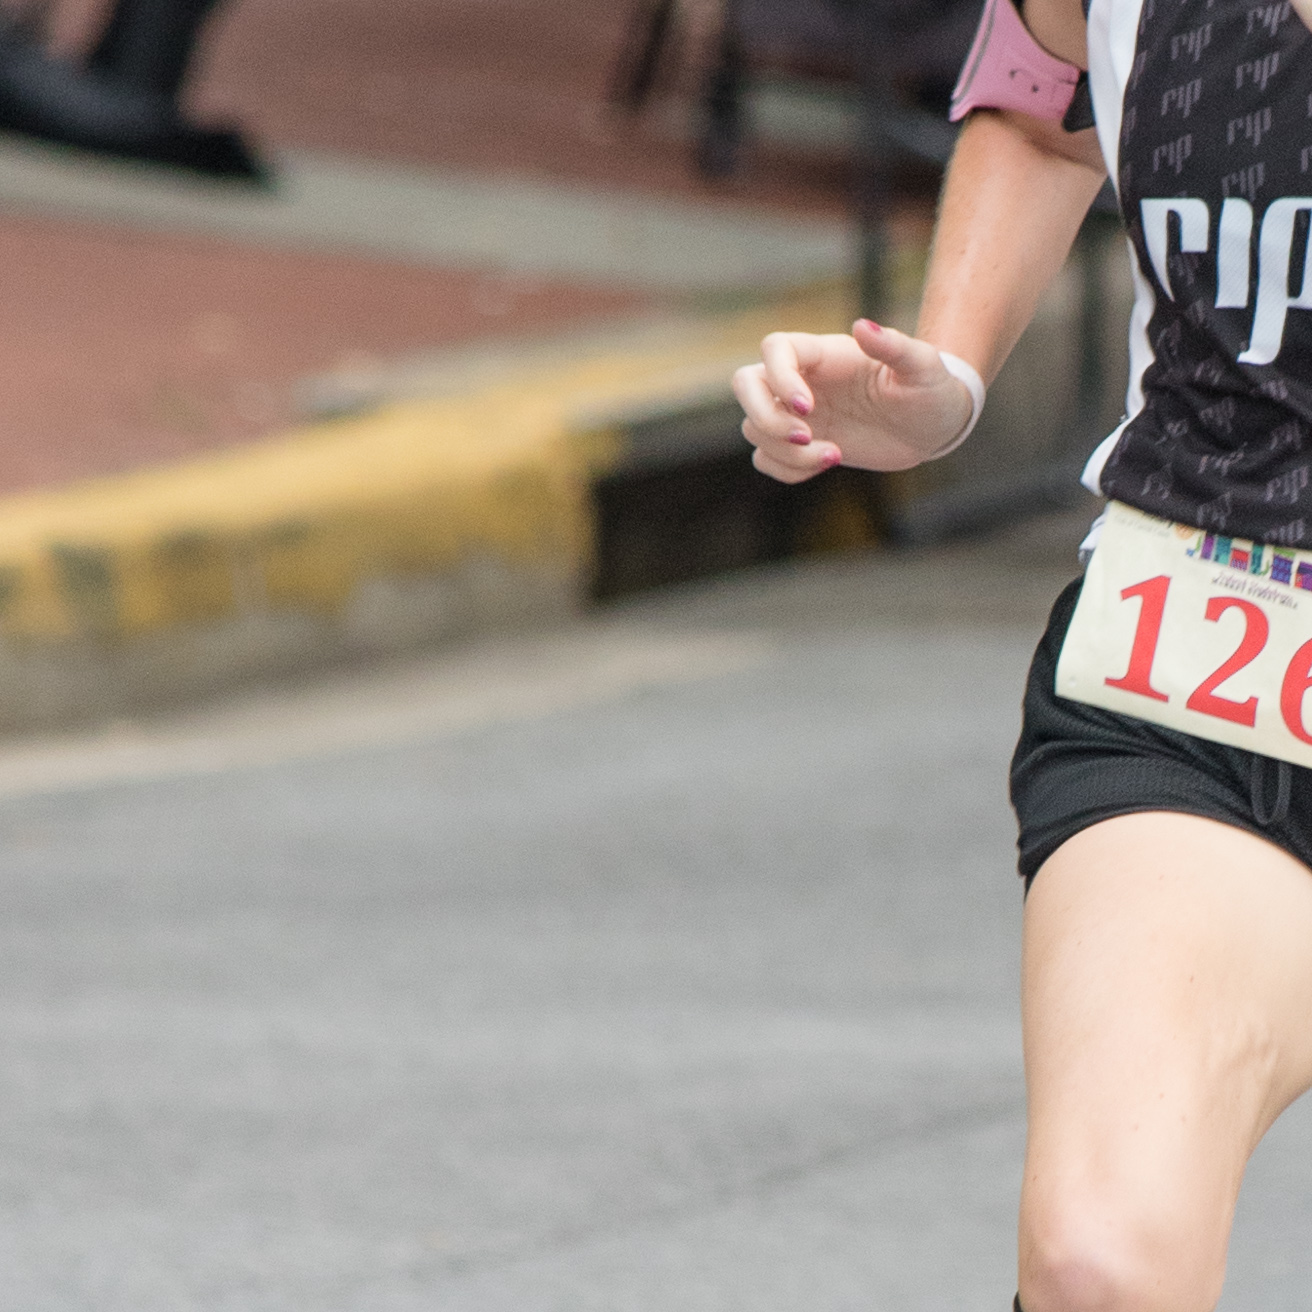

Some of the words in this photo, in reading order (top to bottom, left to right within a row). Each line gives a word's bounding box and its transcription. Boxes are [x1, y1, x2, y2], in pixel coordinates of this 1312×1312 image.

[1246, 0, 1291, 37] rip
[1170, 23, 1213, 63] rip
[1235, 51, 1280, 91] rip
[1161, 78, 1202, 119] rip
[1227, 106, 1272, 147] rip
[1153, 133, 1193, 175] rip
[1220, 162, 1265, 202] rip
[1265, 465, 1310, 504] rip
